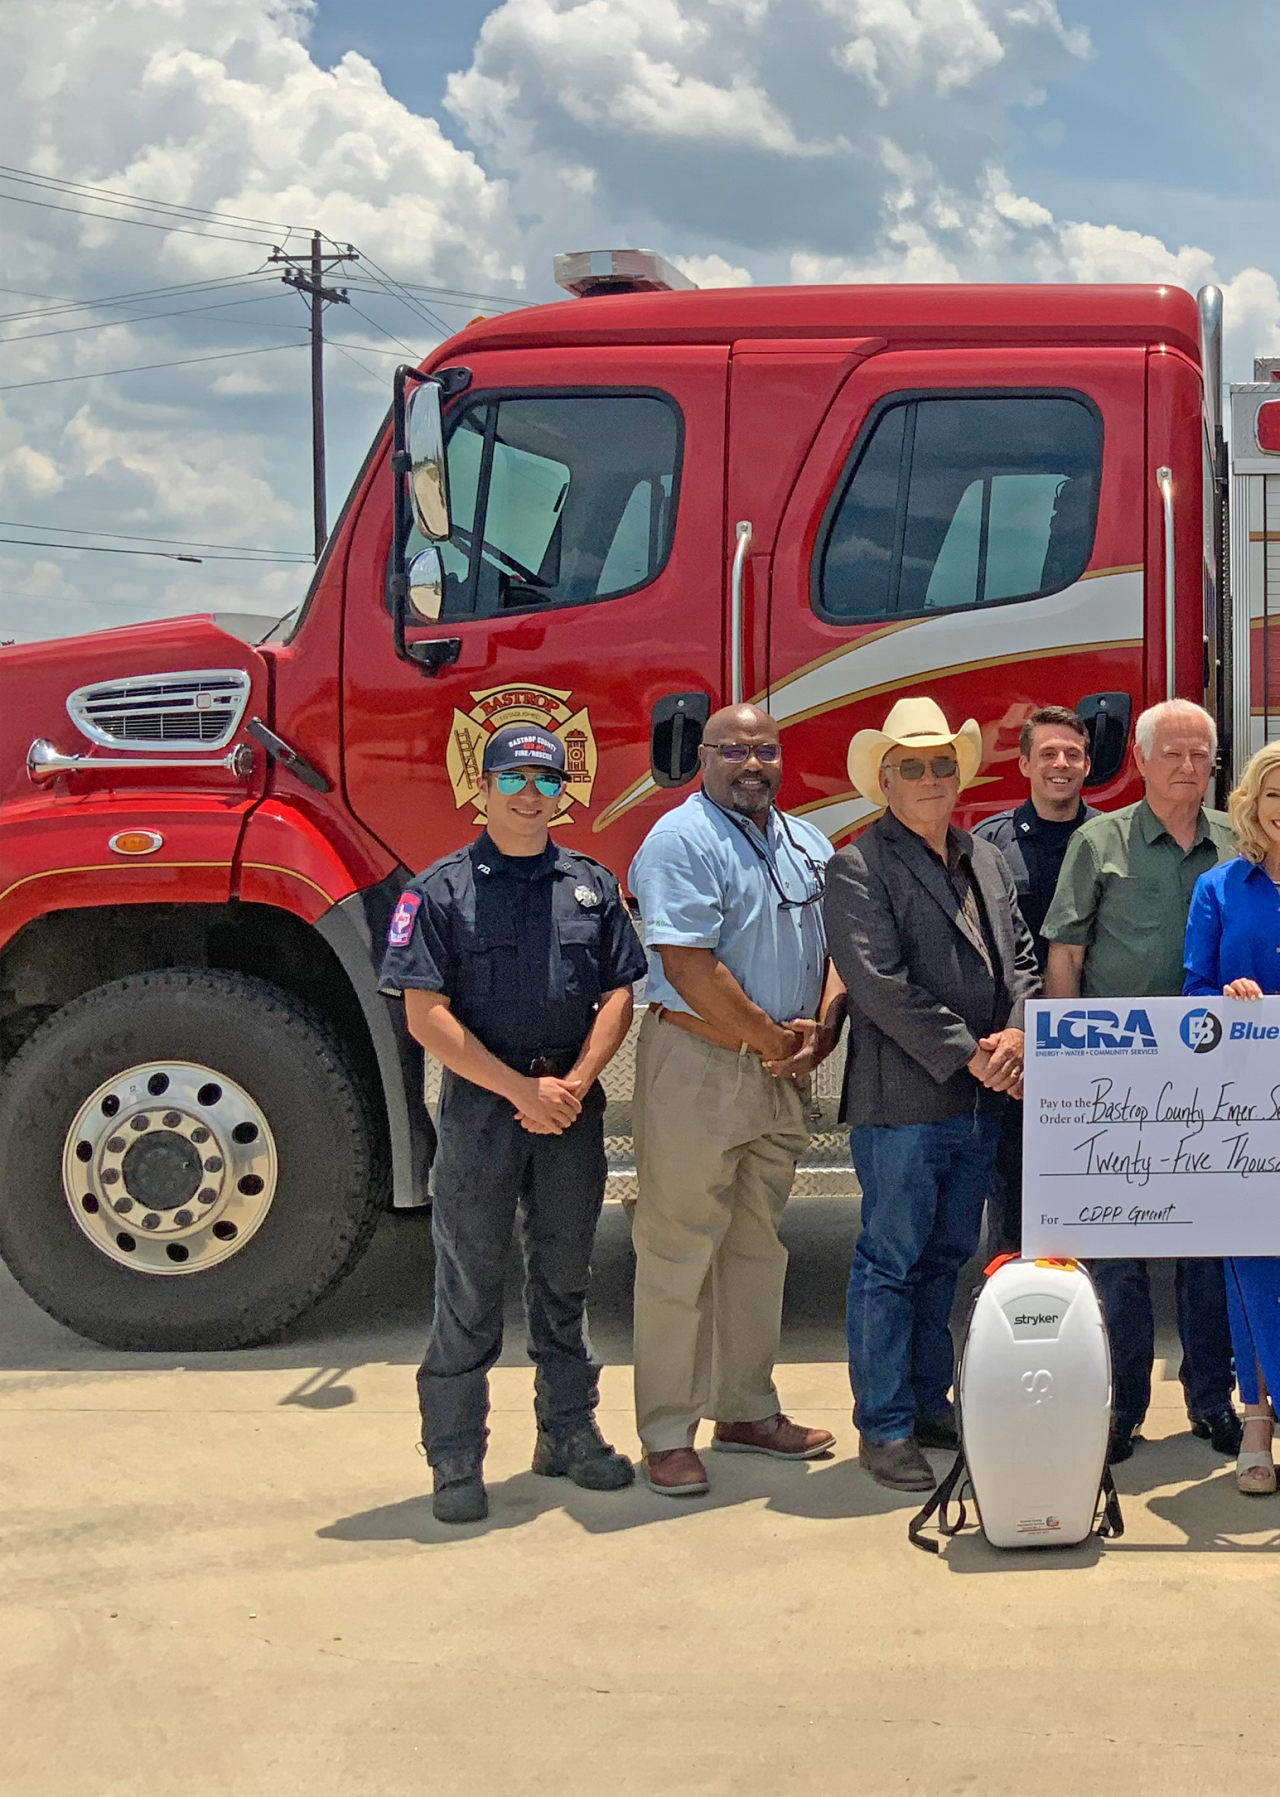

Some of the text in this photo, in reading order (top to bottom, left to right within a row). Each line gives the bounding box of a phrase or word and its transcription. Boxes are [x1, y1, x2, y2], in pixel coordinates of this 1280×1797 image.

[479, 691, 560, 716] BASTROP
[508, 736, 536, 748] BASTROP
[537, 736, 557, 752] COUNTY
[1036, 1010, 1158, 1050] LCRA
[1040, 1098, 1091, 1109] Pay to the
[1090, 1078, 1149, 1131] Bastrop
[1155, 1081, 1204, 1132] County
[1039, 1113, 1087, 1124] Order of
[1041, 1214, 1059, 1225] For
[1078, 1203, 1176, 1226] CDPP Grant
[1013, 1313, 1059, 1326] stryker
